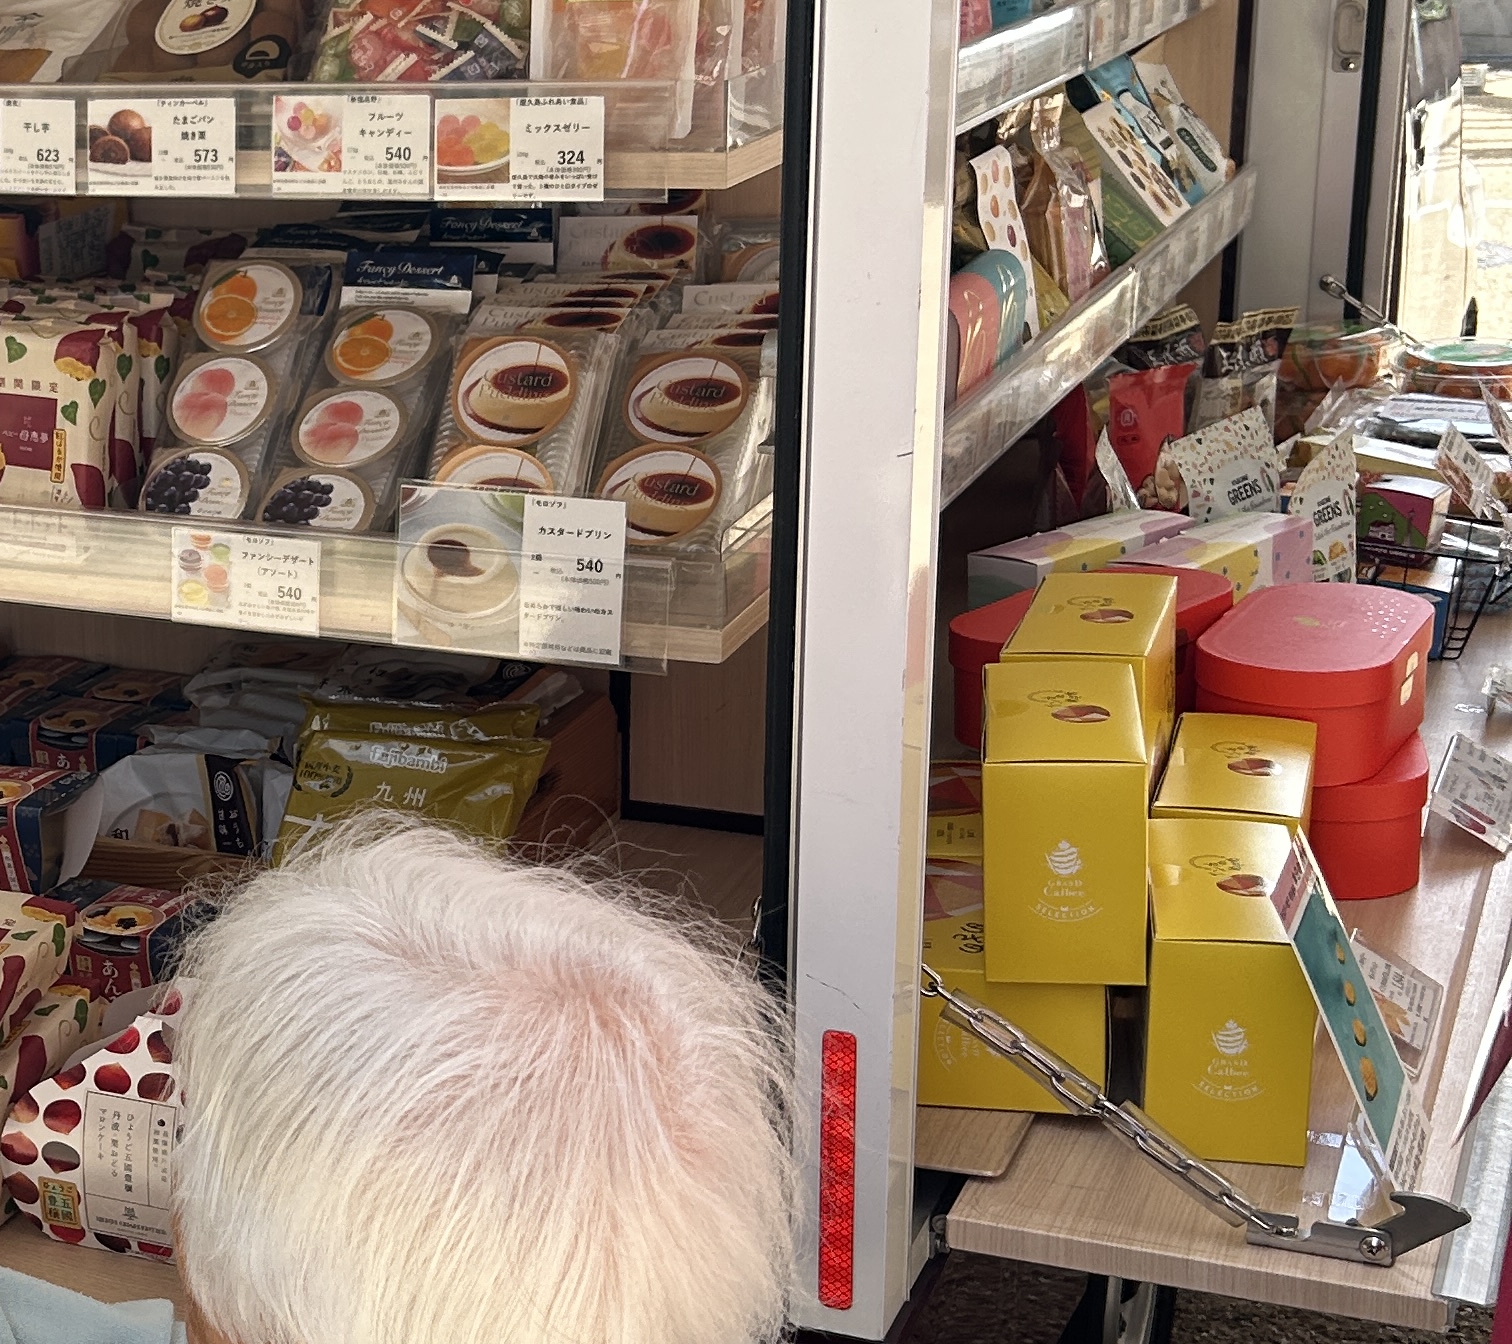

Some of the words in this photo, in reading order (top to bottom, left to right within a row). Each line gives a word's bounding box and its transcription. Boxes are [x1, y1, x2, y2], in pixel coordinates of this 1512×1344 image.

[172, 114, 215, 126] たまごパン
[368, 112, 404, 122] フルーツ
[23, 122, 51, 134] 干し芋
[359, 127, 413, 138] キャンディー
[525, 122, 591, 134] ミックスゼリー
[36, 148, 60, 163] 623
[193, 148, 219, 164] 573
[385, 146, 412, 162] 540
[557, 149, 586, 165] 324
[482, 366, 553, 388] Custard
[656, 378, 726, 399] Custard
[630, 470, 700, 497] Custard
[1227, 478, 1263, 506] GREENS
[1312, 501, 1343, 528] GREENS
[537, 525, 613, 540] カスタードプリン
[241, 550, 315, 566] ファンシーデザート
[576, 557, 604, 574] 540
[277, 585, 303, 601] 540
[372, 780, 427, 808] 九州
[97, 1107, 107, 1161] マロンケーキ
